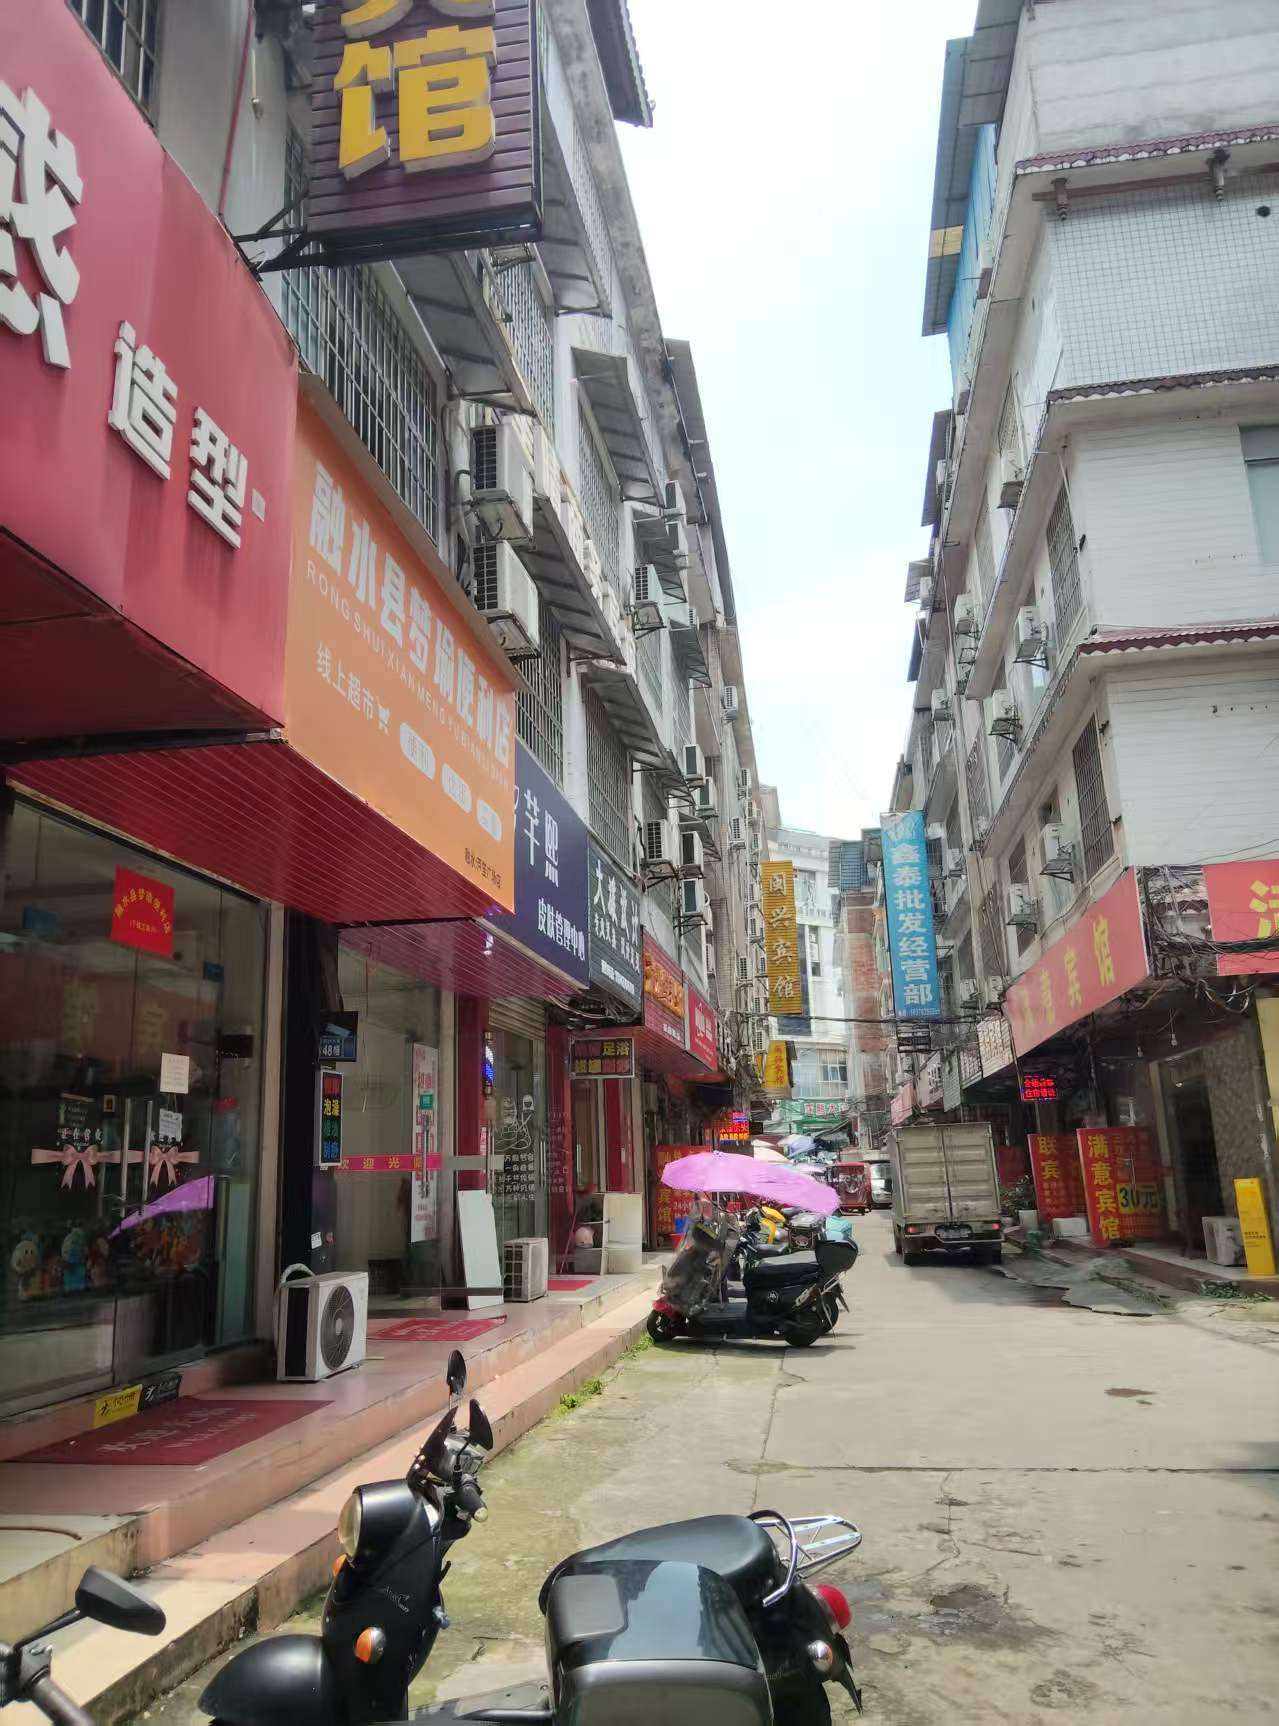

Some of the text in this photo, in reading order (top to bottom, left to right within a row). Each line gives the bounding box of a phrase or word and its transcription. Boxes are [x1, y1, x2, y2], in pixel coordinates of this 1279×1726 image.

[108, 320, 248, 549] 造型
[514, 785, 560, 888] 芊熙
[537, 897, 586, 961] 皮肤管理中心
[1087, 1135, 1121, 1241] 满意宾馆
